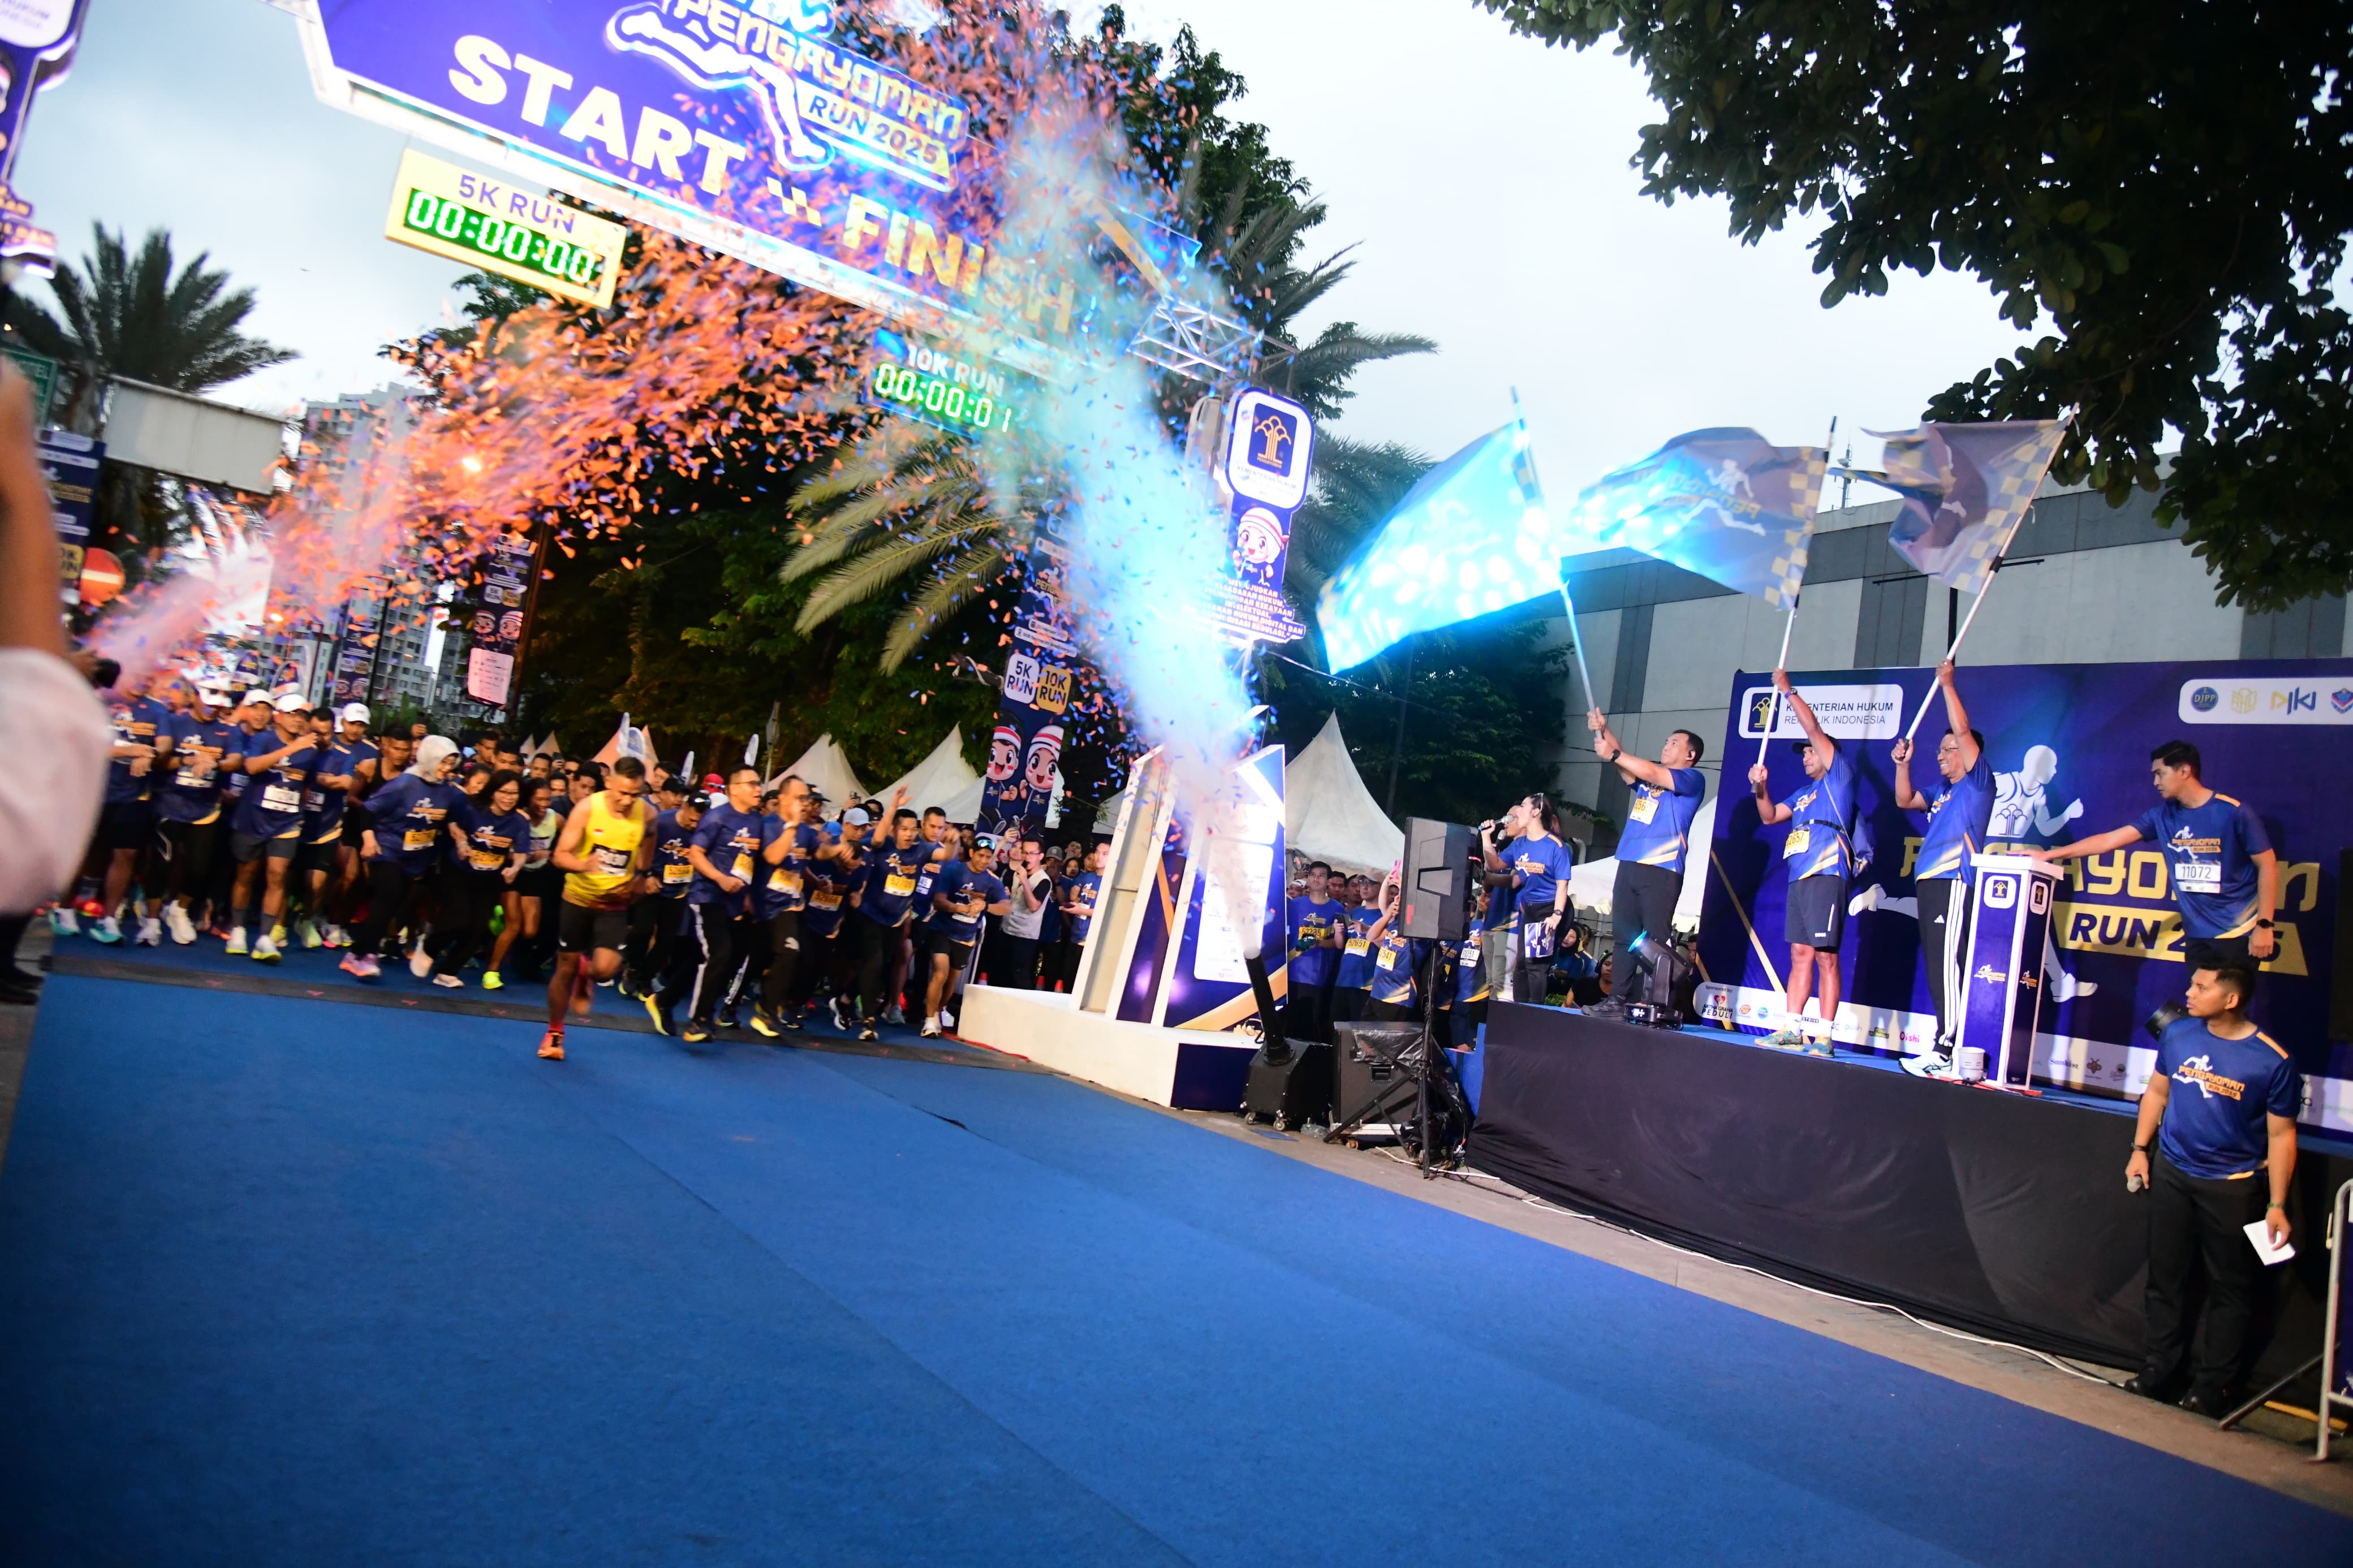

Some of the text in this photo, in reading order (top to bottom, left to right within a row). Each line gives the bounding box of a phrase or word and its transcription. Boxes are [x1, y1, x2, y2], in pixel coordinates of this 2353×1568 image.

[448, 34, 746, 196] START
[808, 94, 940, 165] RUN 2025
[459, 174, 576, 234] 5K RUN
[407, 191, 596, 284] 00:00:00
[908, 343, 1006, 396] 10K RUN
[874, 362, 1012, 433] 00:00:01
[1255, 599, 1293, 617] KEKAYAAN
[1259, 594, 1285, 608] HUKUM,
[1234, 610, 1260, 622] HUKUM
[1260, 617, 1287, 630] DIGITAL
[1288, 624, 1303, 634] DAN
[1015, 660, 1032, 679] 5K
[1007, 674, 1035, 696] RUN
[1046, 670, 1067, 690] 10K
[1040, 685, 1066, 706] RUN
[2194, 694, 2216, 703] DJPP
[1857, 702, 1893, 711] HUKUM
[1833, 715, 1885, 724] INDONESIA
[2182, 866, 2212, 879] 11072
[2070, 913, 2162, 949] RUN
[1348, 939, 1366, 948] 52651
[1701, 1008, 1733, 1019] PEDULI
[1900, 1031, 1920, 1043] Oishi
[2049, 1059, 2079, 1070] Sunkist
[2178, 1065, 2245, 1092] PENGAYOMAN
